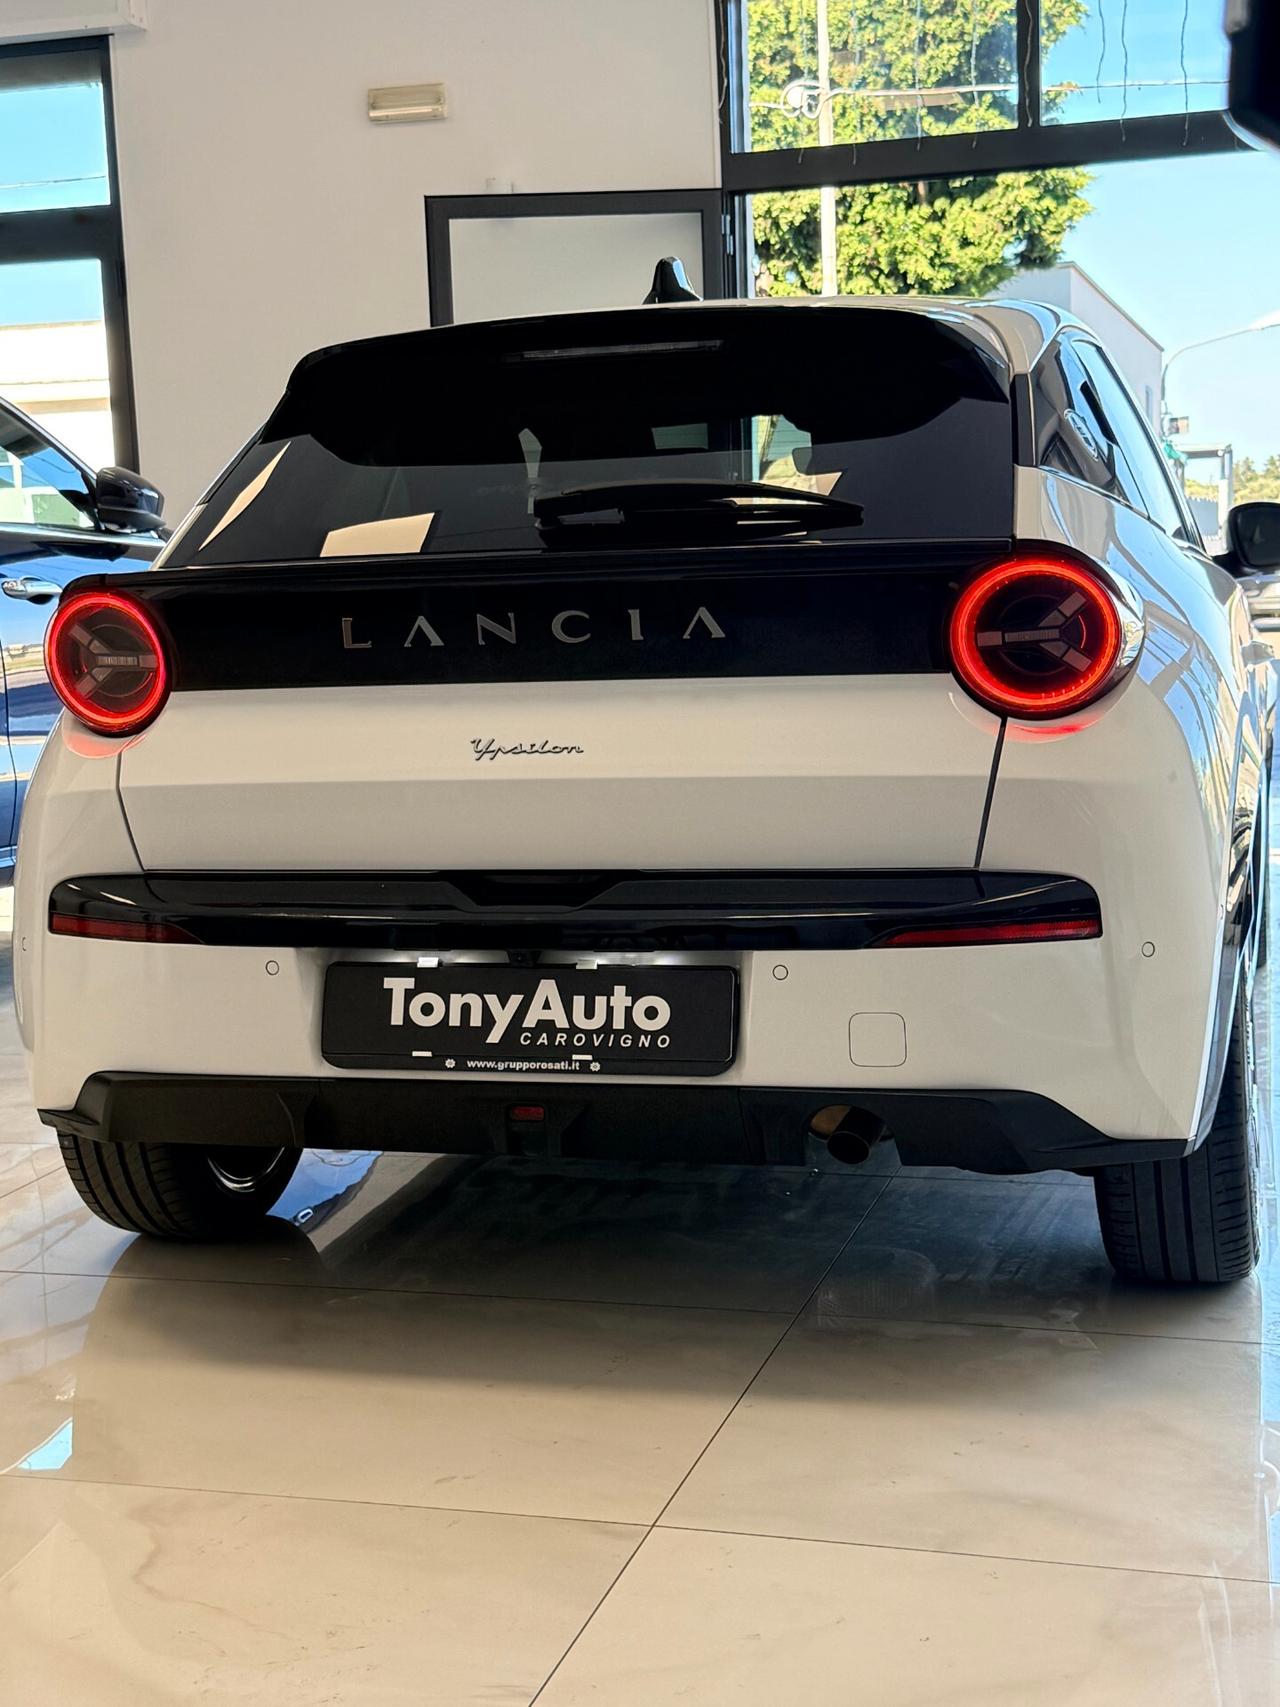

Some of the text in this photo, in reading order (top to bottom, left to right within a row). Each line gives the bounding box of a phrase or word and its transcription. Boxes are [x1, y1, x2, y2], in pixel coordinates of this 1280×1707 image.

[341, 606, 726, 649] LANCIA
[470, 738, 585, 762] Ypsilon
[383, 977, 671, 1044] TonyAuto
[519, 1032, 671, 1048] CAROVIGNO
[466, 1059, 580, 1072] www.grupporosati.it
